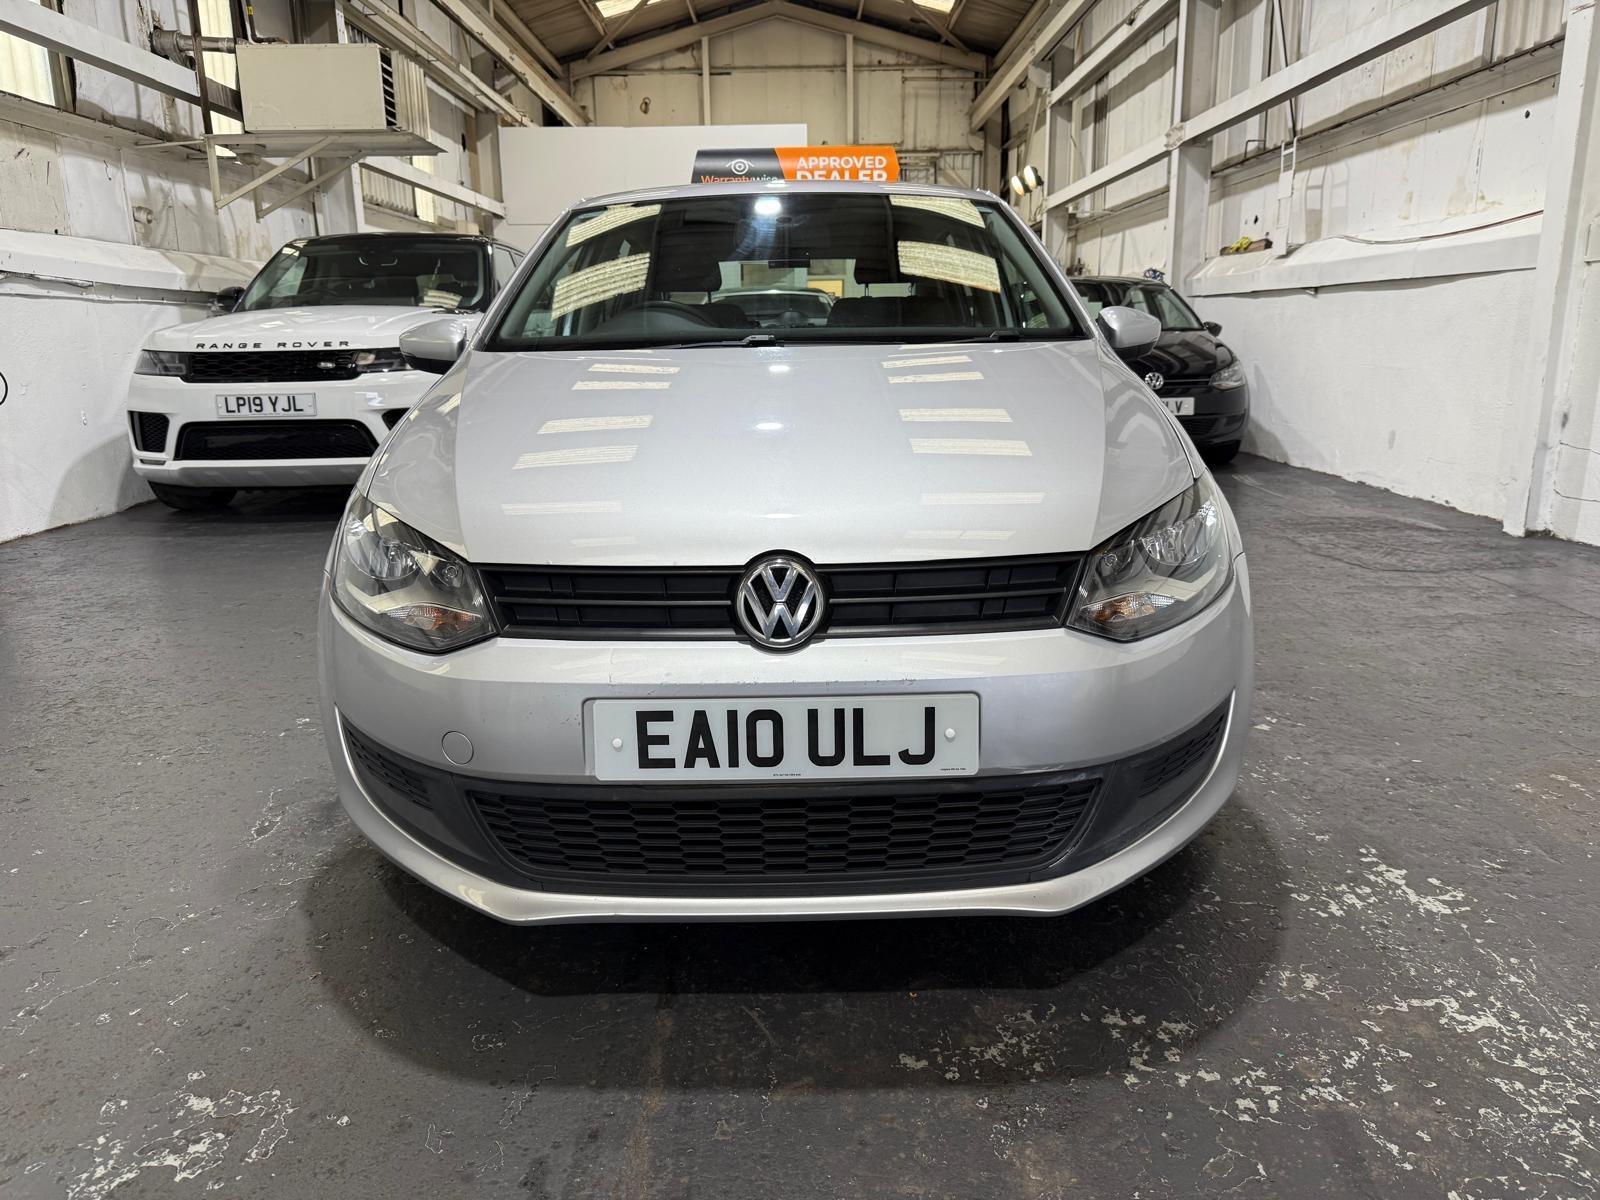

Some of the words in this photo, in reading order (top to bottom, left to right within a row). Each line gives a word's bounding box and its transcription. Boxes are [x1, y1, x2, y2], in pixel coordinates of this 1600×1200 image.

[796, 156, 887, 169] APPROVED
[796, 169, 888, 182] DEALER
[195, 342, 263, 350] RANGE
[276, 340, 351, 349] ROVER
[224, 396, 264, 414] LP19
[268, 395, 305, 413] YJL
[635, 708, 785, 769] EA10
[806, 706, 937, 767] ULJ
